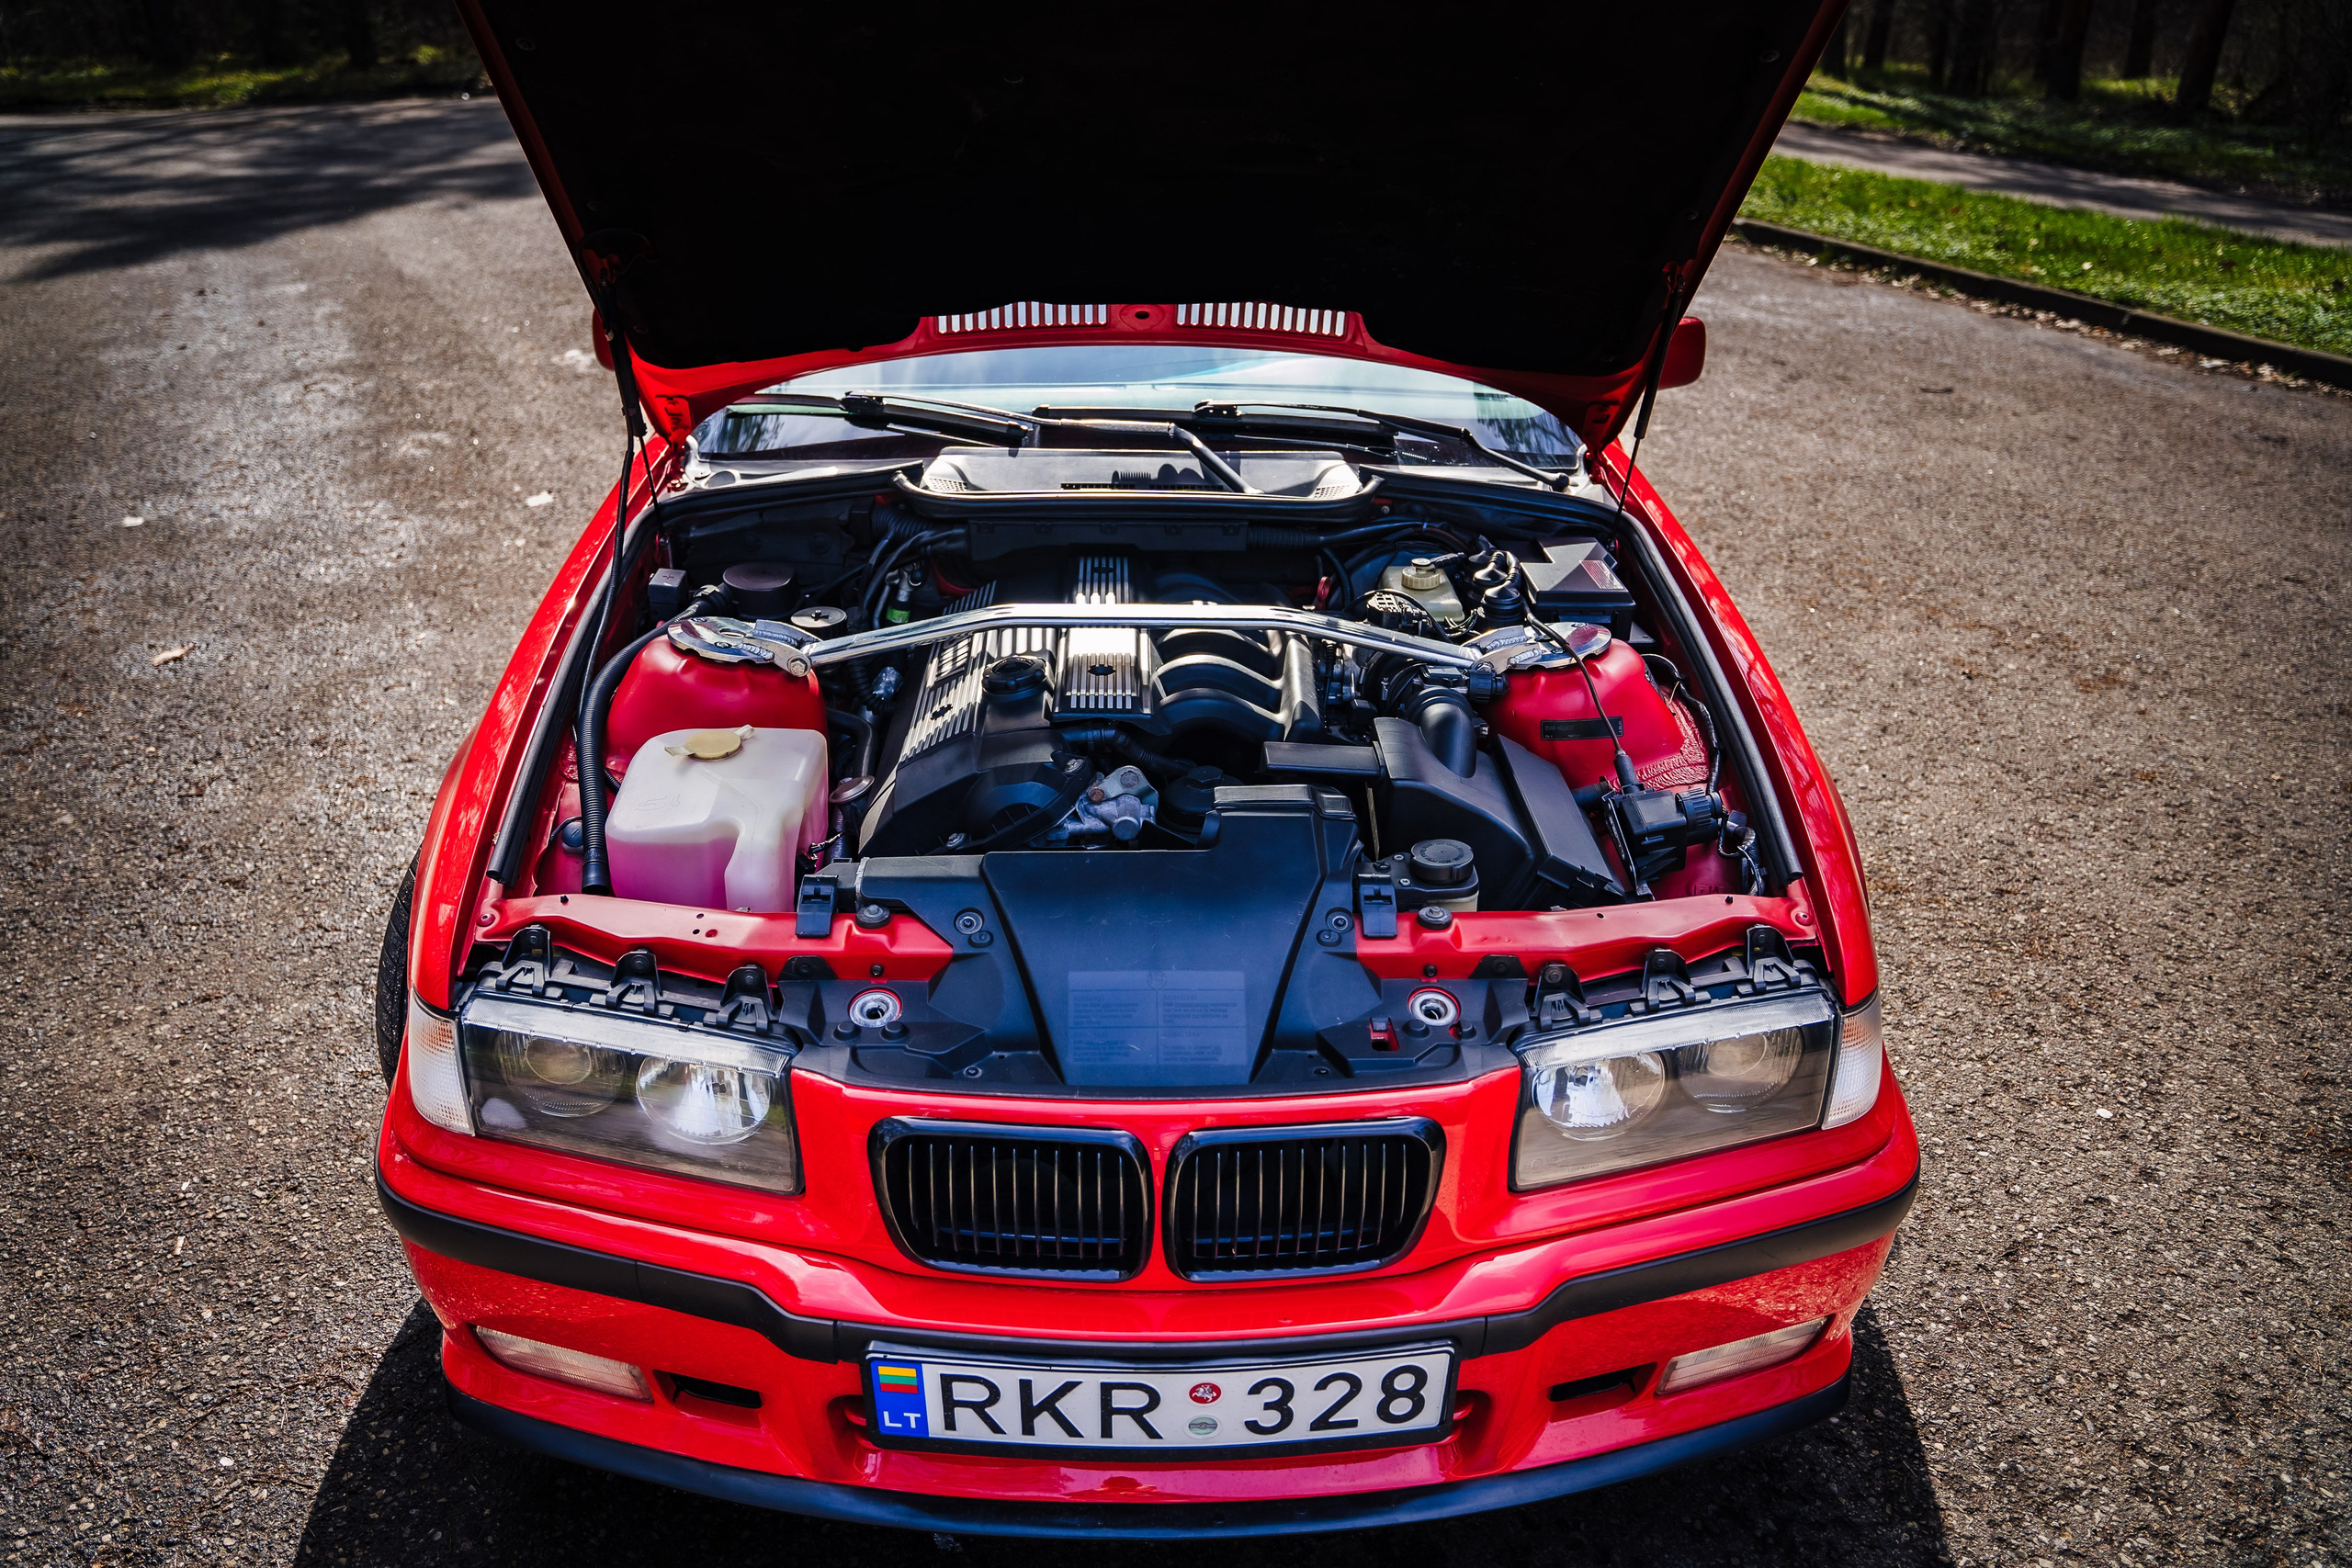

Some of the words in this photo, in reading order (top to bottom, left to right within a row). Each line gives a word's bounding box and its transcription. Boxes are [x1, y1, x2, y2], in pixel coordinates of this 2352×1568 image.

[883, 1410, 922, 1429] LT
[939, 1372, 1164, 1440] RKR
[1244, 1364, 1429, 1436] 328
